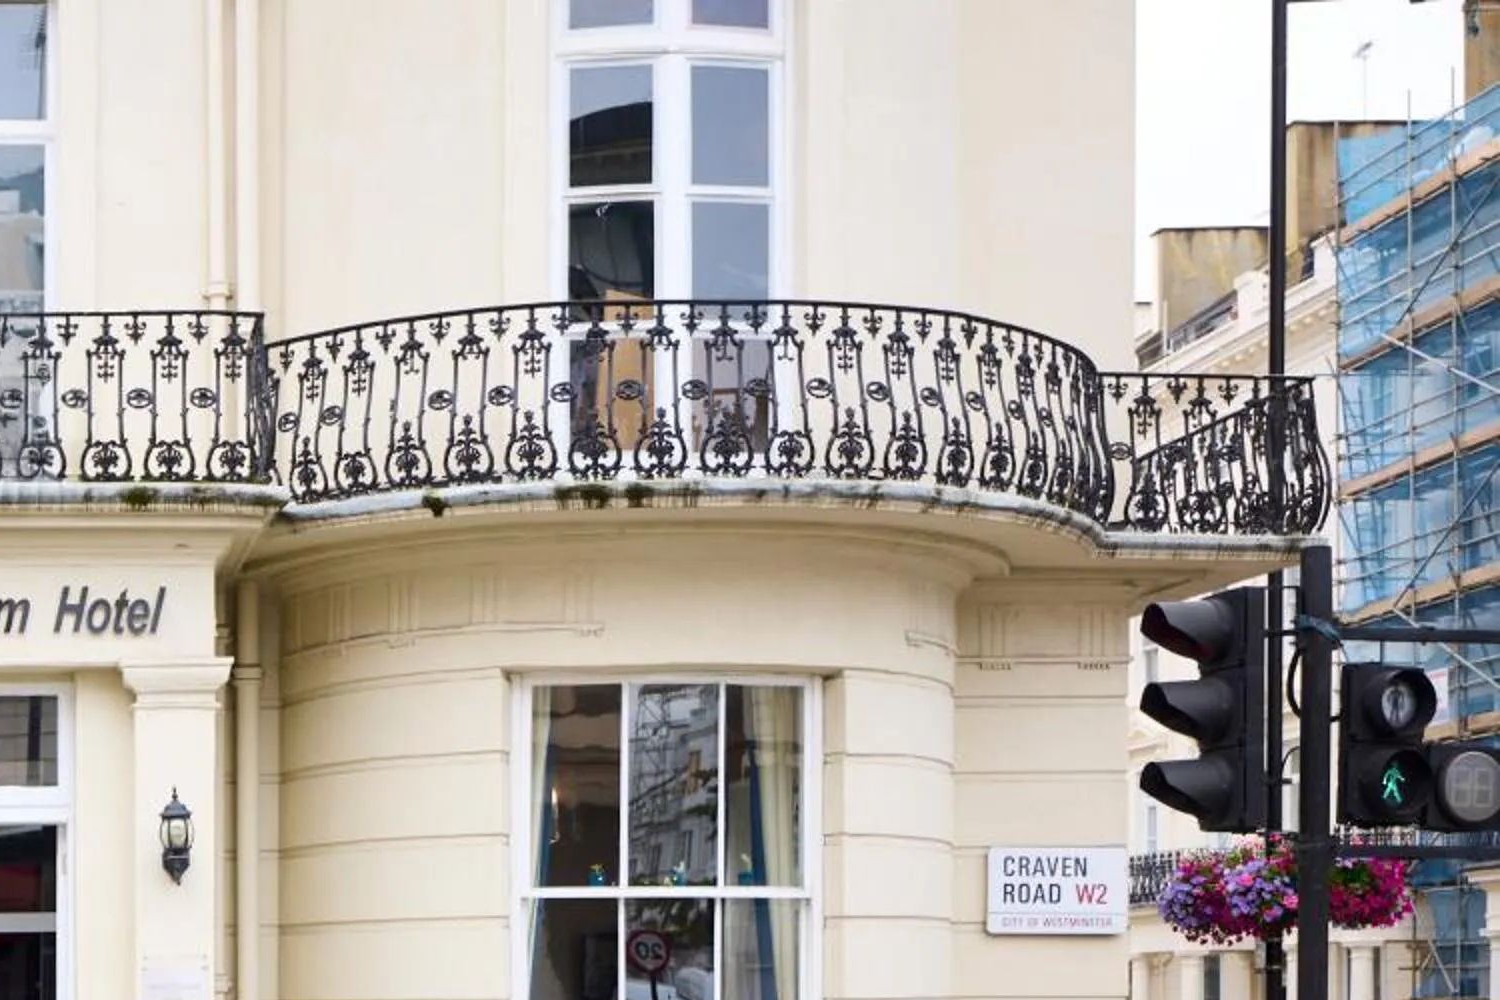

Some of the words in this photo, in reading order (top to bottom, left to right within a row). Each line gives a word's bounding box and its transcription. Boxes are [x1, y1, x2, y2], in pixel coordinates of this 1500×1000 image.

[53, 586, 167, 636] Hotel
[1003, 855, 1087, 877] CRAVEN
[1002, 883, 1061, 905] ROAD
[1075, 883, 1108, 905] W2
[1001, 917, 1024, 928] CITY
[1027, 917, 1039, 928] OF
[1043, 916, 1113, 929] WESTMINSTER
